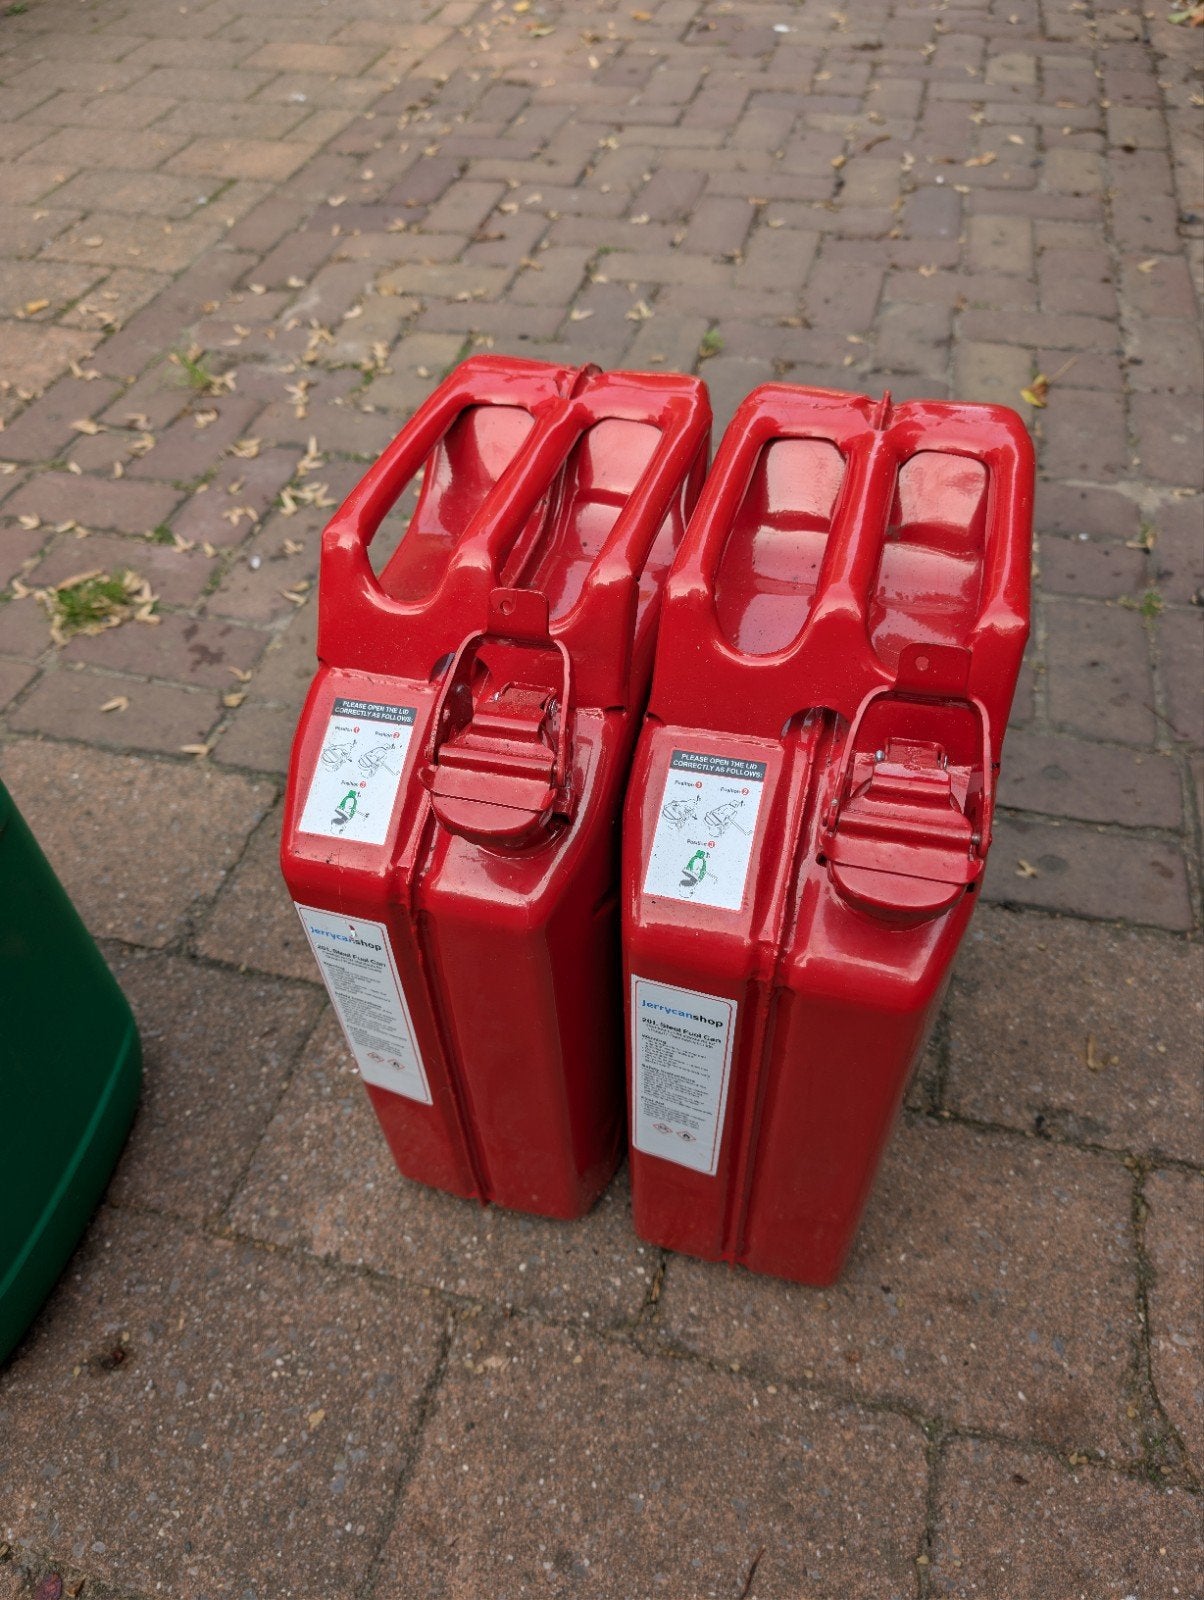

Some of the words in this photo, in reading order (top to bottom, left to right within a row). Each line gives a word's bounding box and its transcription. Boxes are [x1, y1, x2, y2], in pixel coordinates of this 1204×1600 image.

[334, 706, 371, 717] CORRECTLY
[371, 711, 380, 719] AS
[342, 701, 367, 710] PLEASE
[367, 704, 385, 712] OPEN
[385, 706, 398, 714] THE
[398, 708, 410, 716] LID
[672, 760, 714, 772] CORRECTLY
[715, 765, 725, 773] AS
[681, 753, 709, 763] PLEASE
[709, 757, 730, 766] OPEN
[730, 760, 745, 769] THE
[745, 762, 758, 770] LID
